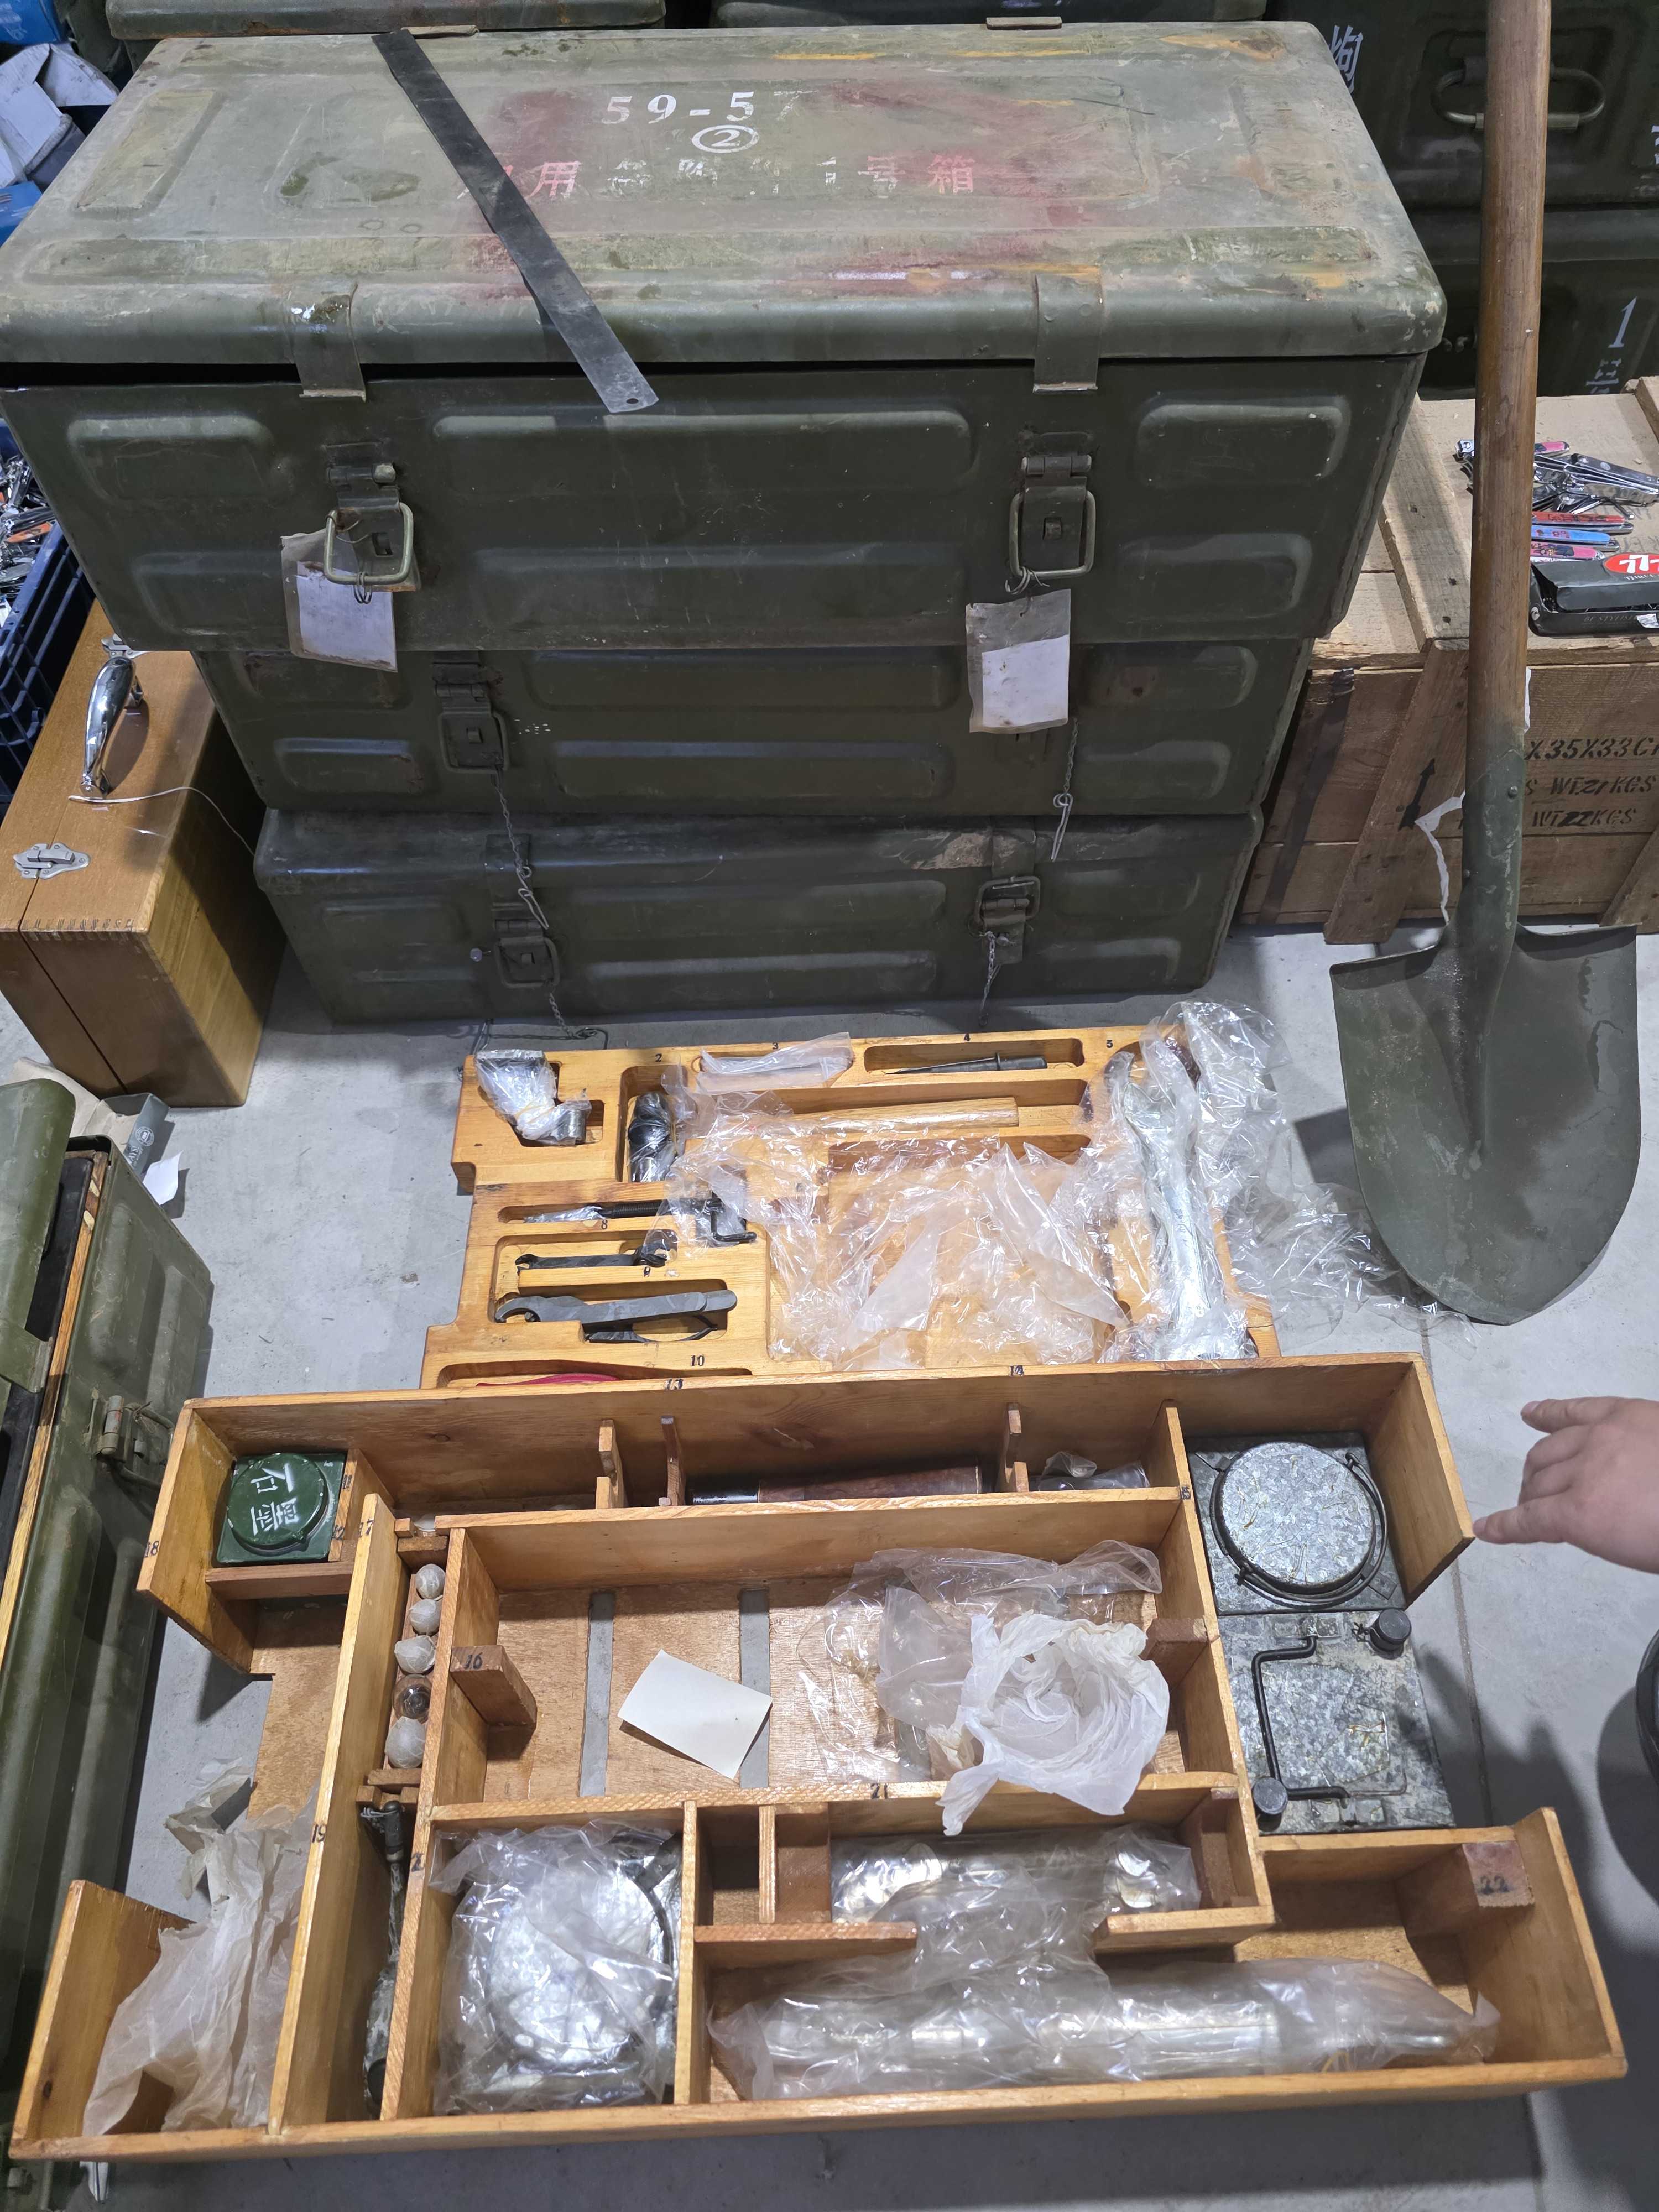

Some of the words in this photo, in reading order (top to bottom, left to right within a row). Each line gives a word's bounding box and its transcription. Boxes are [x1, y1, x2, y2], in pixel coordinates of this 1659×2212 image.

[964, 1033, 971, 1042] 4
[655, 1053, 662, 1062] 2
[601, 1219, 608, 1229] 8
[690, 1354, 705, 1367] 10
[250, 1463, 299, 1536] 石墨
[465, 1652, 483, 1670] 16
[871, 1782, 888, 1799] 21
[311, 1824, 327, 1843] 19
[1479, 1875, 1509, 1895] 22
